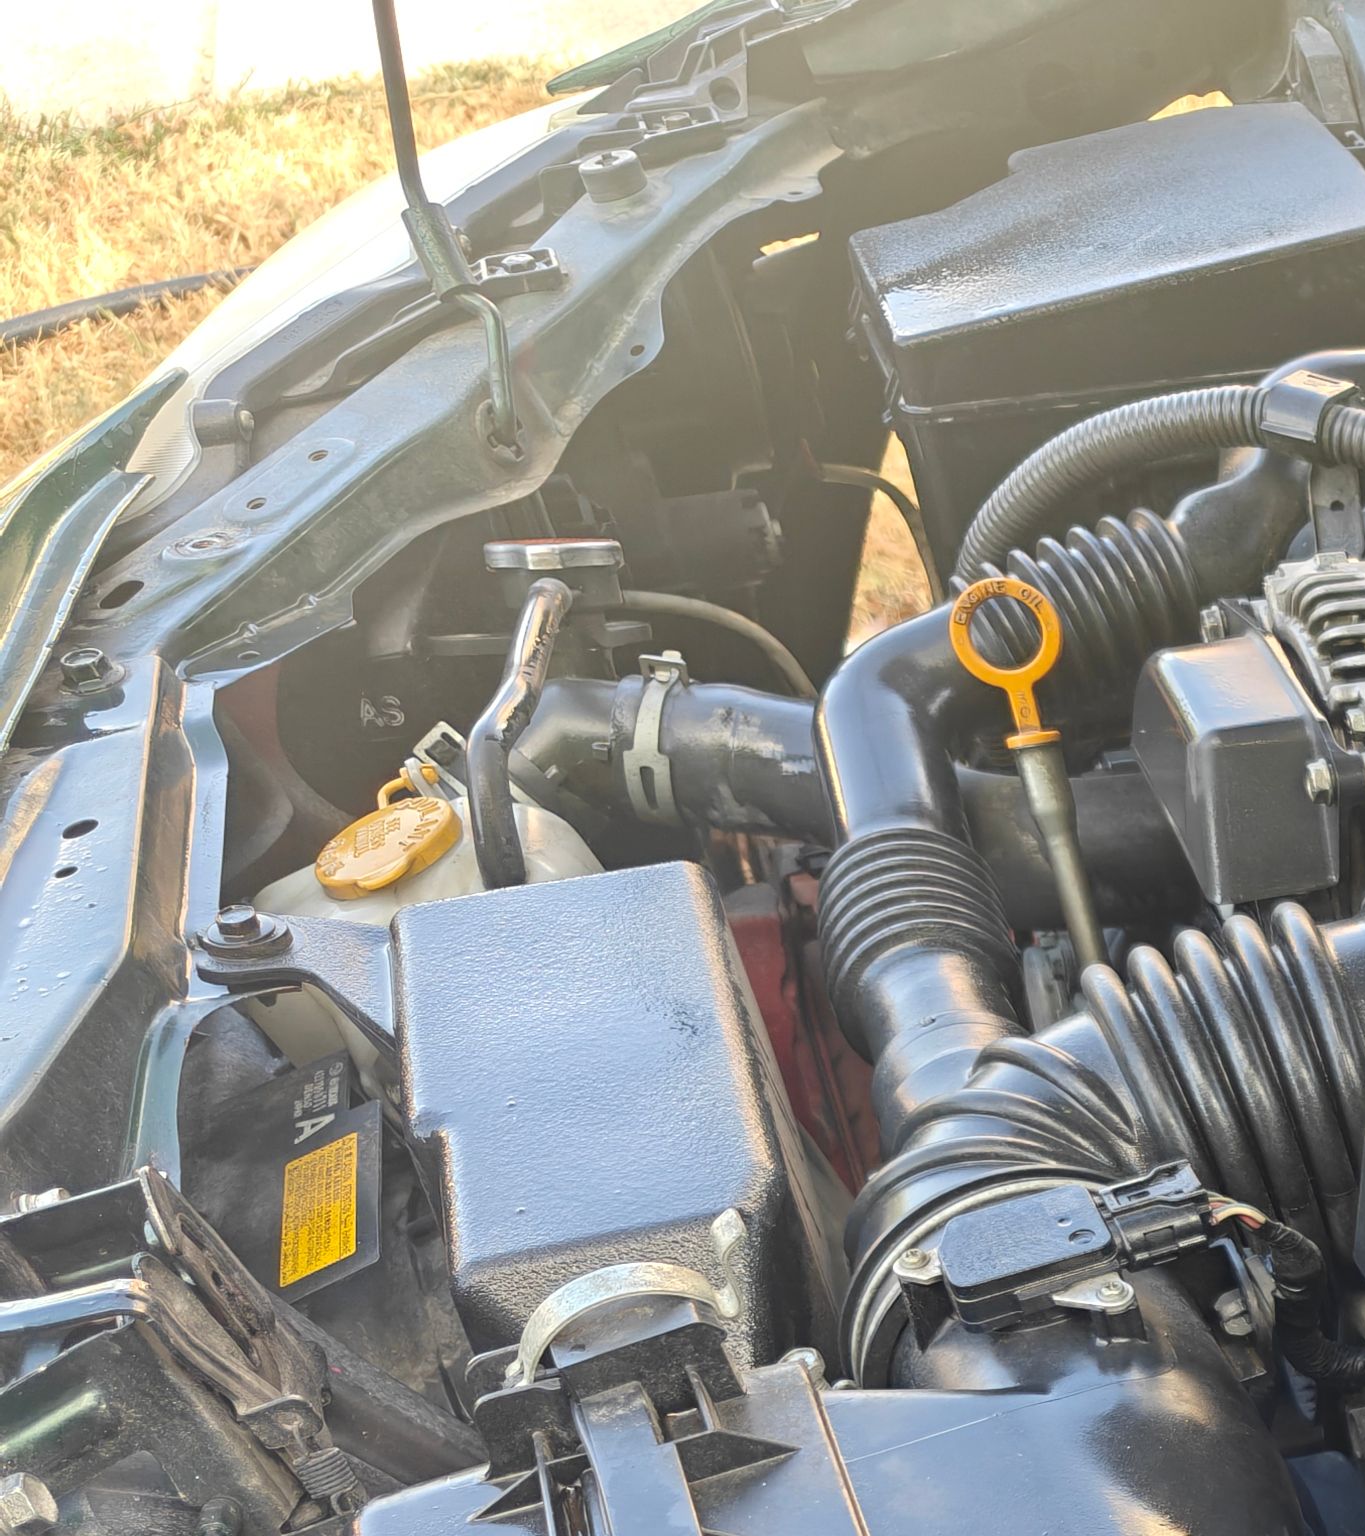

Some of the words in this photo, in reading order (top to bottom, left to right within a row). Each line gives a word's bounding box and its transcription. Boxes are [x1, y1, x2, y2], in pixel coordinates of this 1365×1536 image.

[954, 580, 1008, 626] ENGINE
[1020, 587, 1044, 615] OIL
[294, 1113, 335, 1144] A
